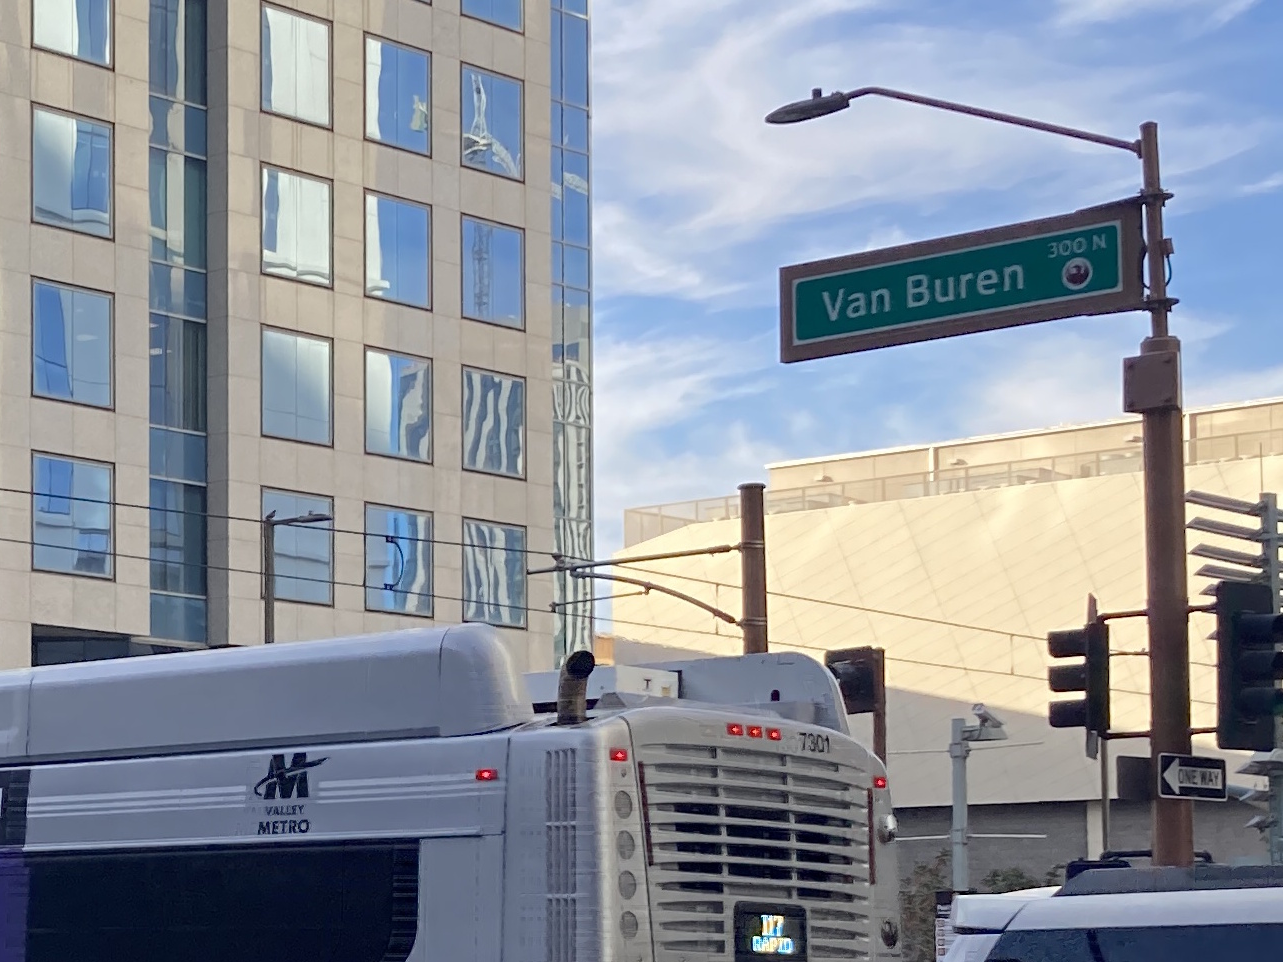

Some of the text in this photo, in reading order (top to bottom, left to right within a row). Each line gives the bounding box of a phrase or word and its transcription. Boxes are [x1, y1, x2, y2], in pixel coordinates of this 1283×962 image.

[1048, 234, 1107, 258] 300 N
[822, 263, 1025, 322] Van Buren
[798, 732, 830, 753] 7301
[1178, 768, 1219, 787] ONE WAY
[265, 804, 305, 816] VALLEY
[257, 819, 309, 835] METRO
